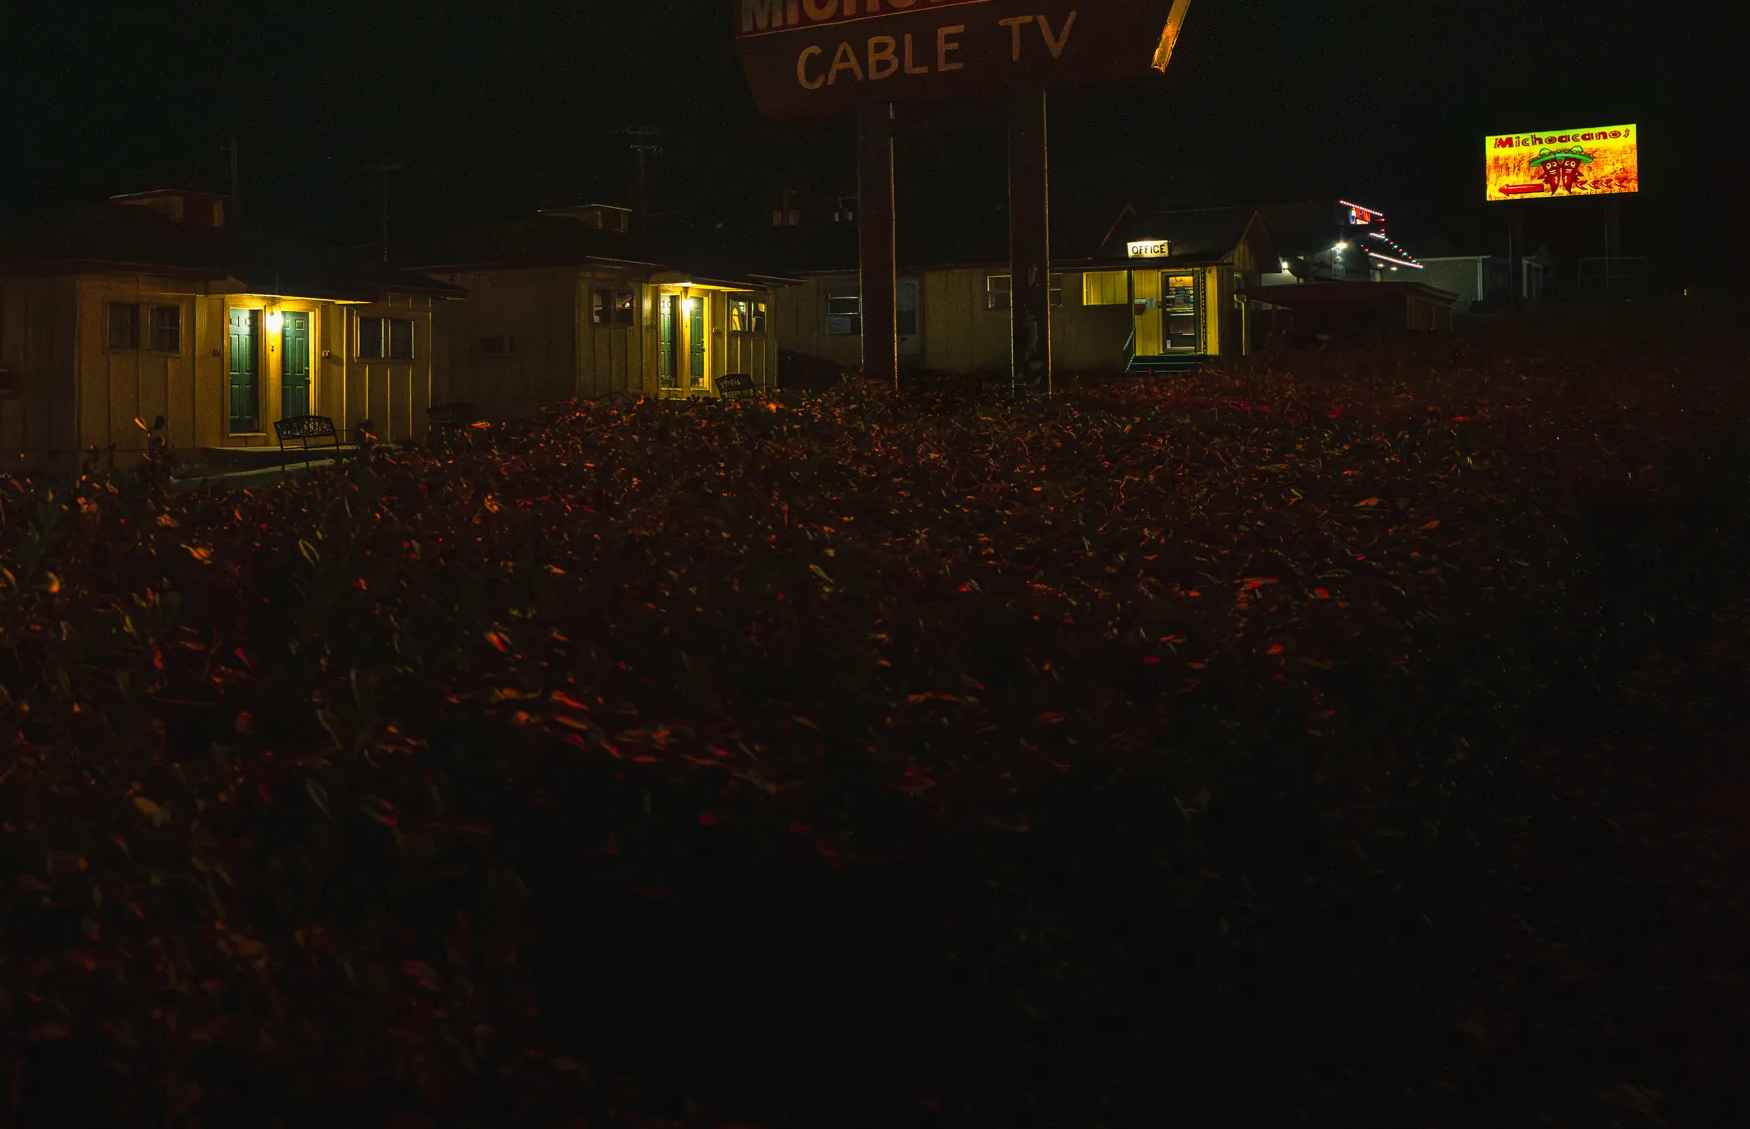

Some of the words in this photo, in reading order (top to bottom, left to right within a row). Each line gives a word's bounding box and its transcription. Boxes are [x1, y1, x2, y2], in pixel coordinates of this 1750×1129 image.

[796, 24, 966, 90] CABLE
[998, 9, 1078, 60] TV
[1494, 128, 1631, 149] Michoacanos
[1131, 244, 1166, 254] OFFICE
